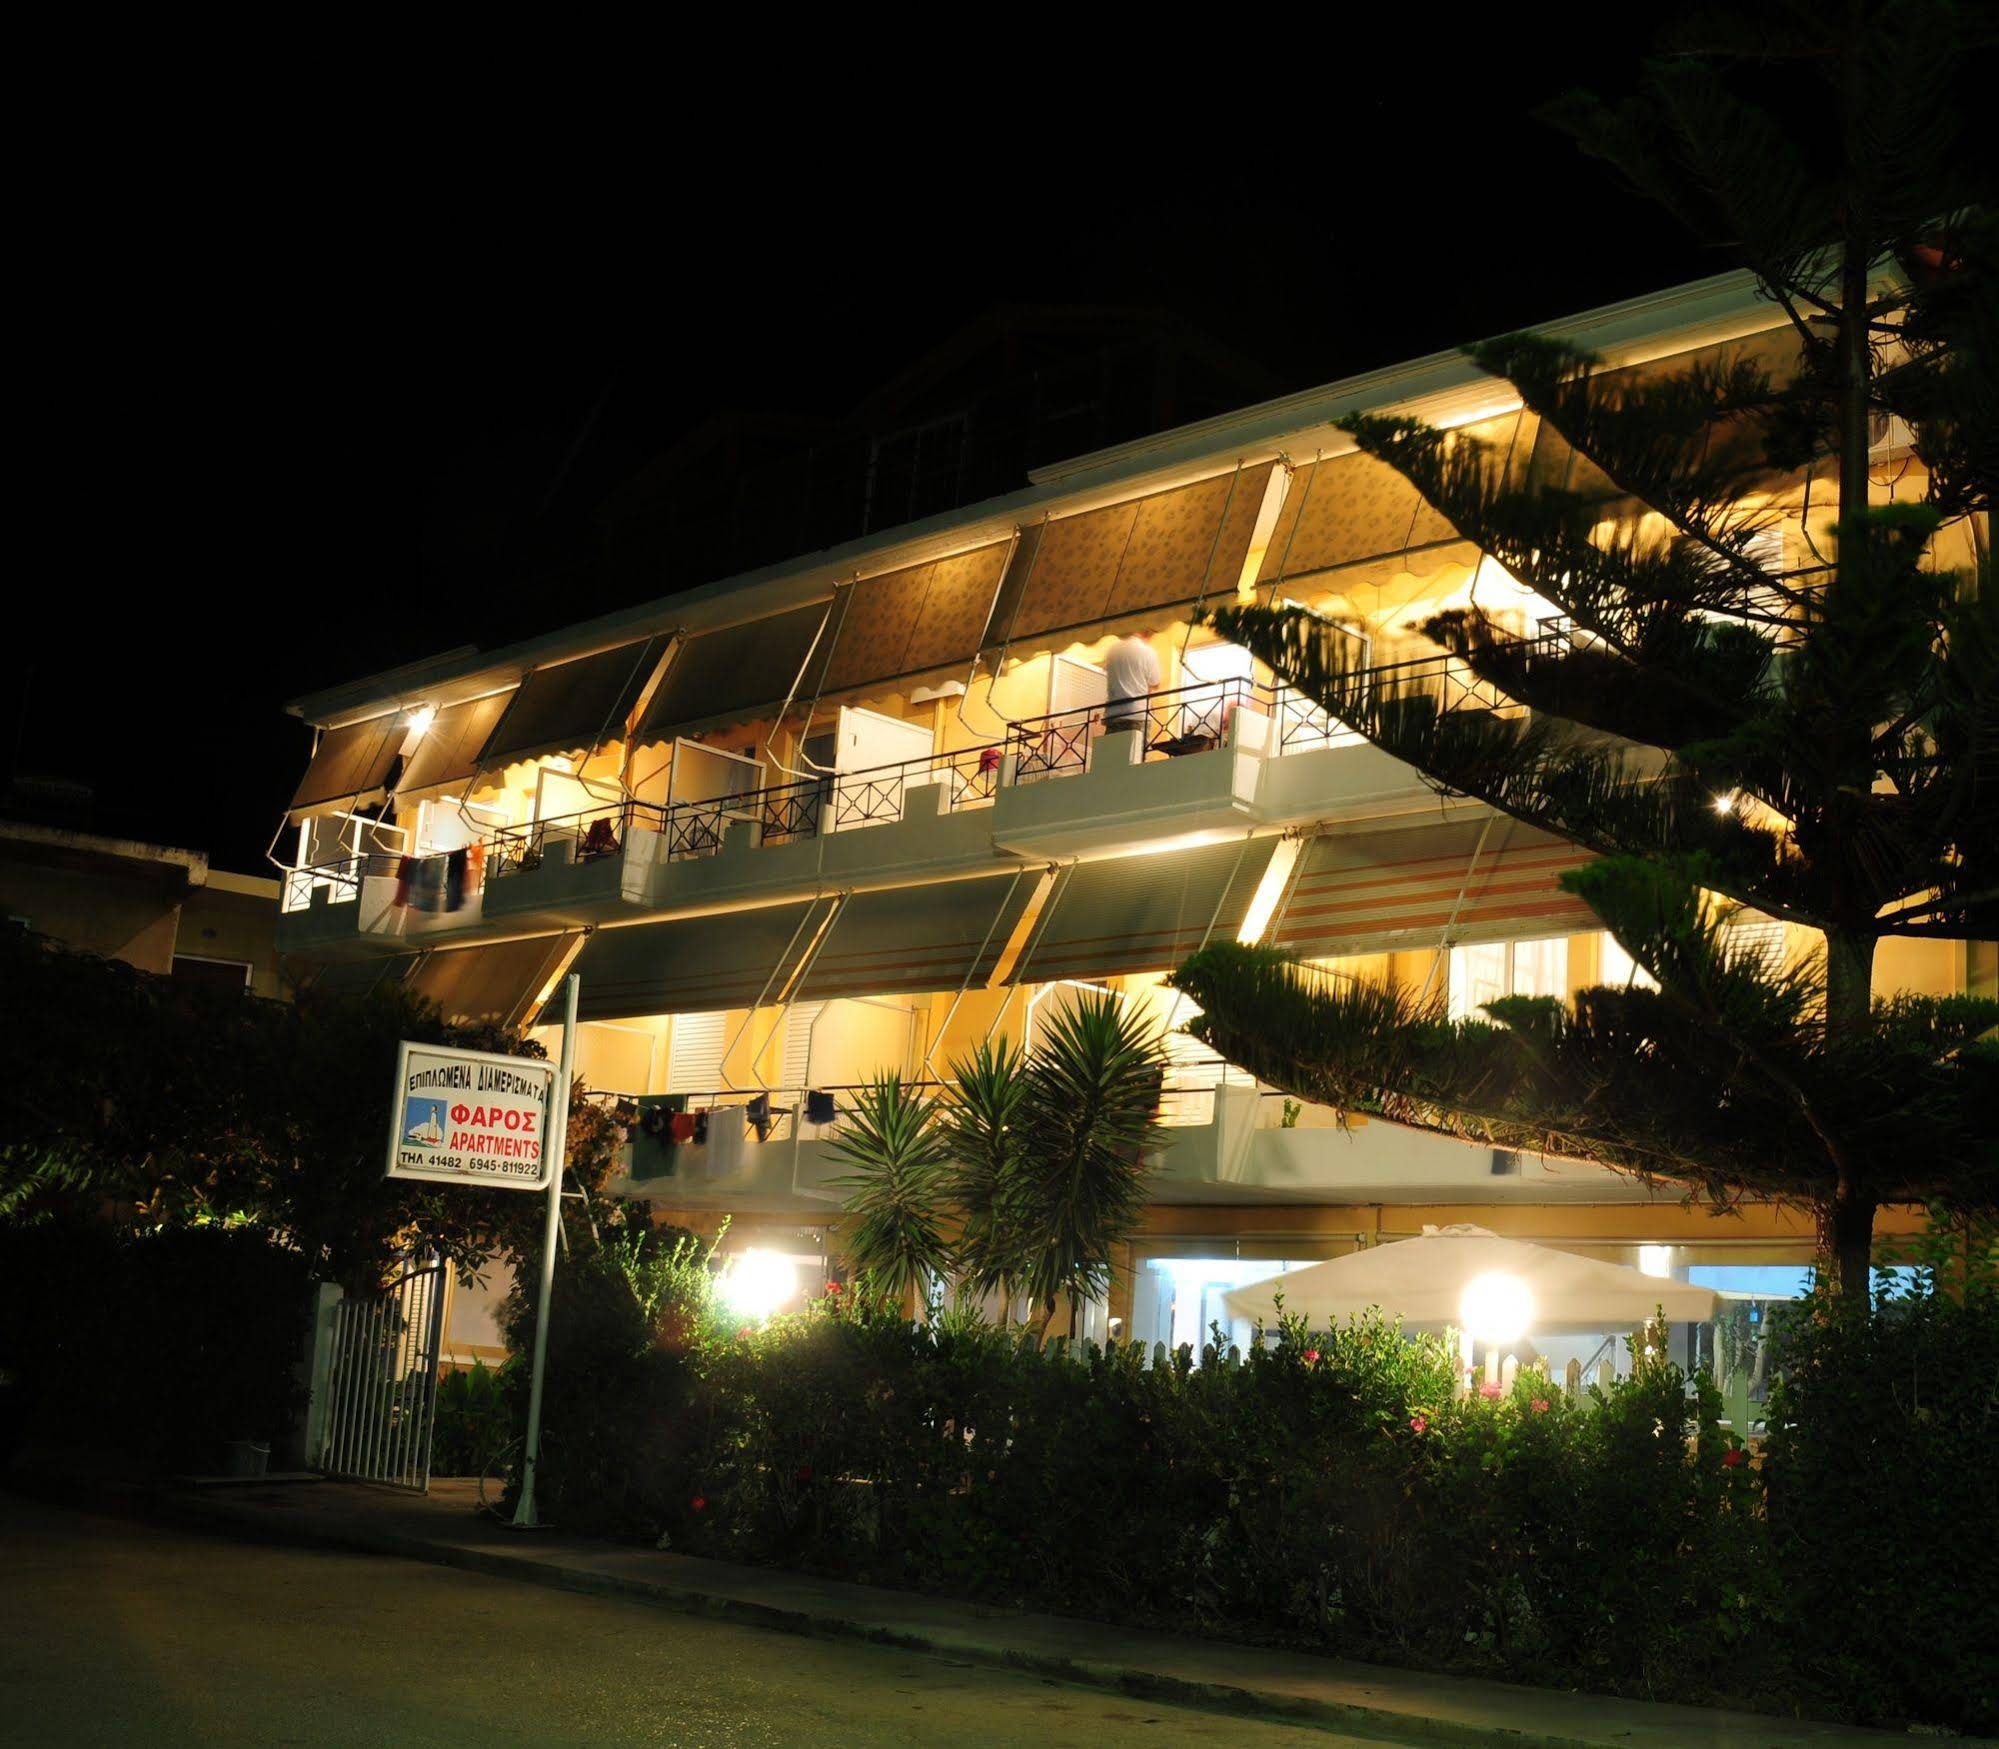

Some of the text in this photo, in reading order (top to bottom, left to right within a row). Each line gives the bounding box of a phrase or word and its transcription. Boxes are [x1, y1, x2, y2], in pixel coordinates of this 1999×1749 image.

[409, 1066, 544, 1103] ΕΠΙΠΛΩΜΕΝΑ ΔΙΑΜΕΡΙΣΜΑΤΑ
[450, 1103, 537, 1132] ΦΑΡΟΣ
[400, 1152, 423, 1164] ΤΗΛ
[428, 1154, 462, 1168] 41482
[449, 1131, 540, 1160] APARTMENTS
